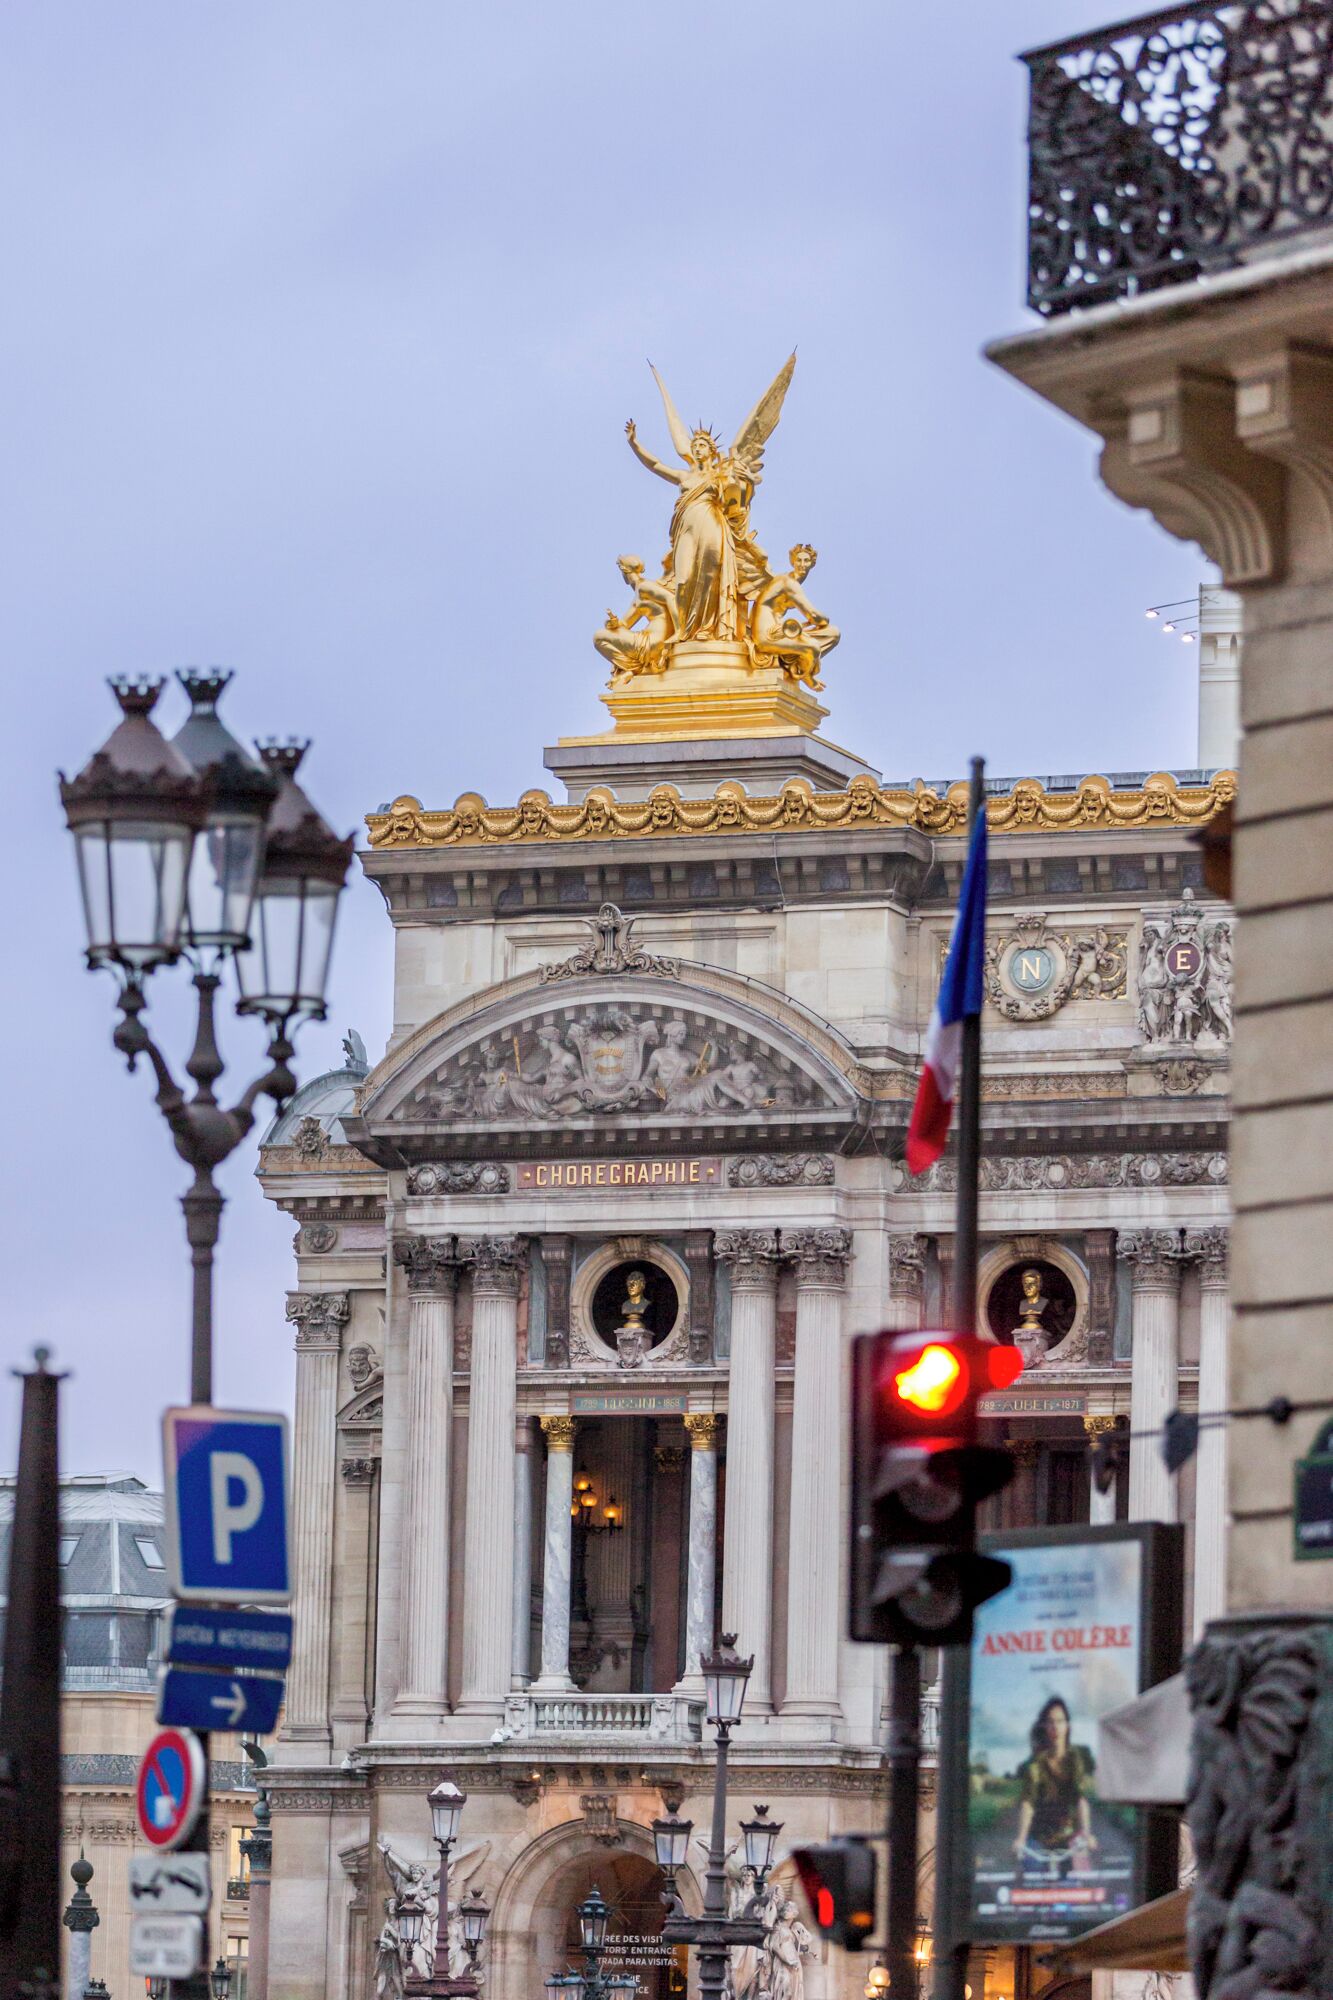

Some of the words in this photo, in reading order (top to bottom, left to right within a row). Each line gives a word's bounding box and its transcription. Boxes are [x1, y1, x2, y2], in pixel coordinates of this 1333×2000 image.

[1021, 957, 1041, 981] N
[1176, 950, 1191, 970] E
[536, 1161, 700, 1186] CHOREGRAPHIE
[1003, 1400, 1053, 1411] AUBER
[209, 1451, 265, 1564] P
[983, 1631, 1046, 1655] ANNIE
[623, 1935, 640, 1943] DES
[631, 1947, 678, 1955] ENTRANCE
[625, 1957, 649, 1966] PARA
[649, 1958, 678, 1966] VISITAS
